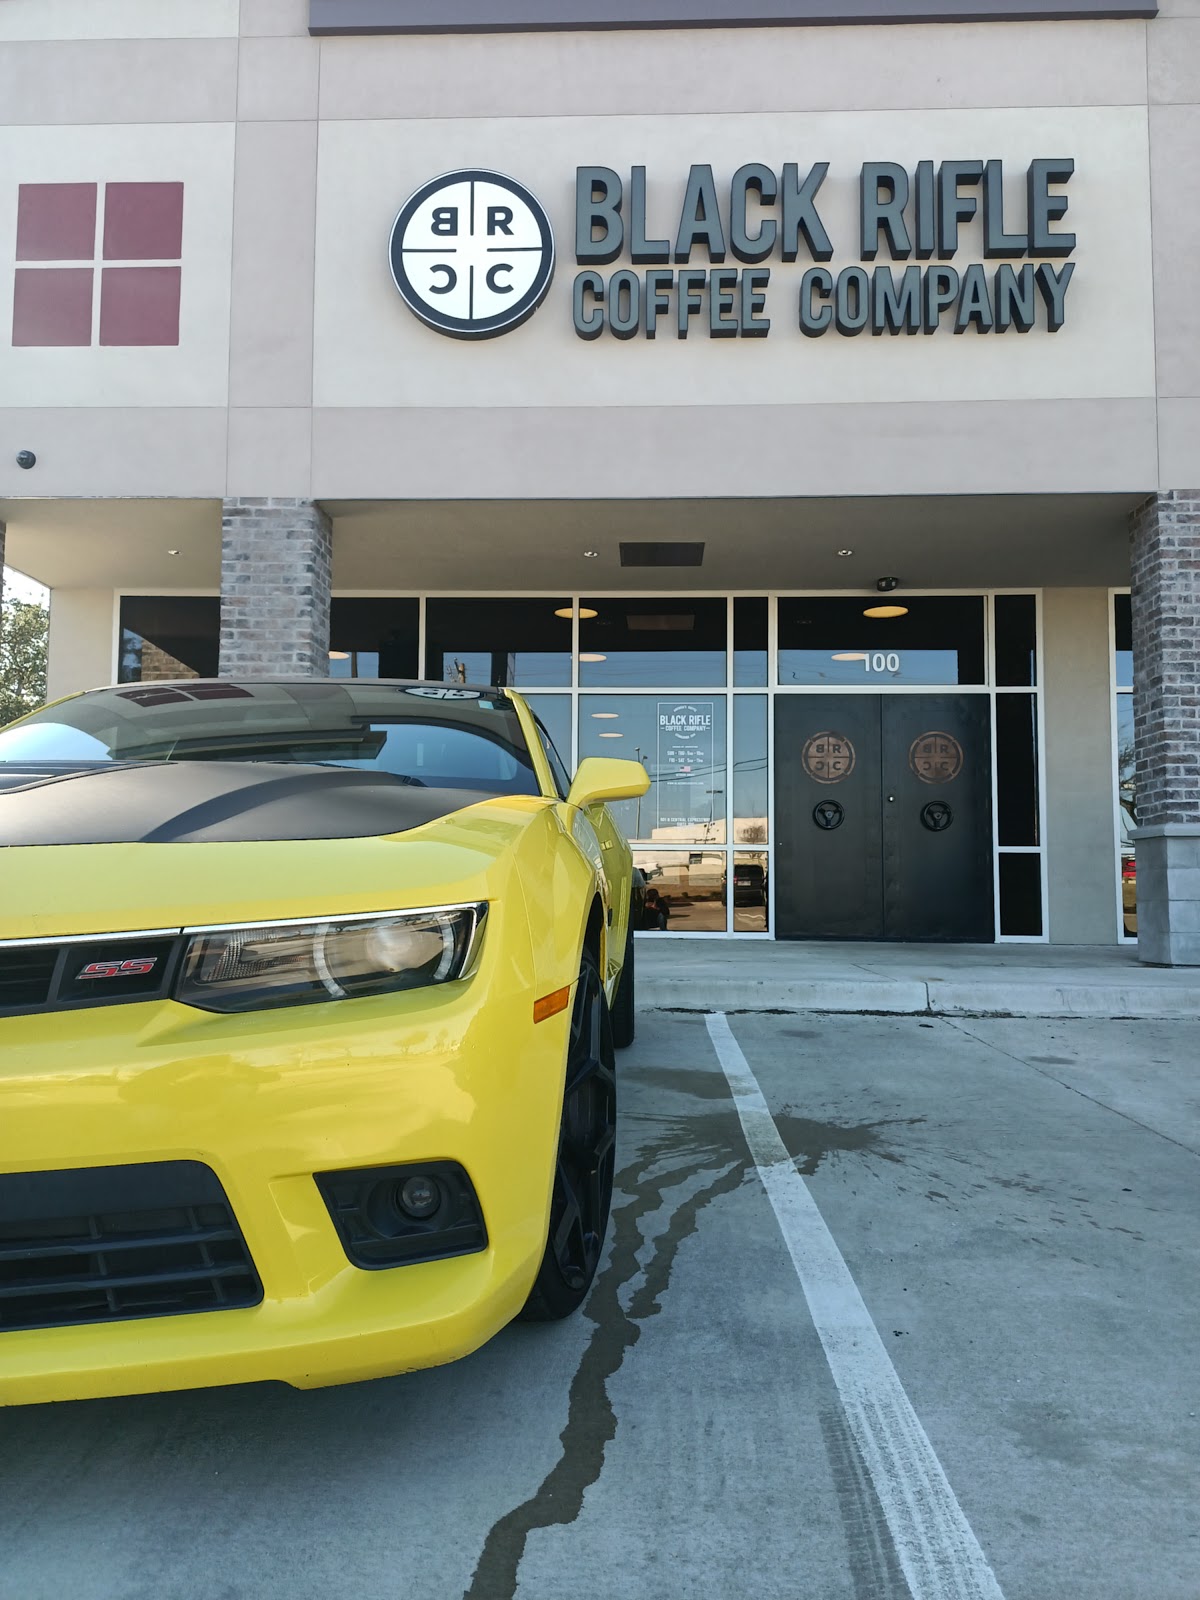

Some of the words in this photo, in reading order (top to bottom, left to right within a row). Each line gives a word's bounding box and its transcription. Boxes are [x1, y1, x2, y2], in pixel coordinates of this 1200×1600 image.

[576, 162, 834, 264] BLACK
[860, 157, 1076, 261] RIFLE
[573, 267, 771, 340] COFFEE
[800, 262, 1076, 338] COMPANY
[864, 653, 900, 672] 100
[660, 714, 687, 726] BLACK
[688, 714, 711, 726] RIFLE
[75, 957, 158, 980] SS
